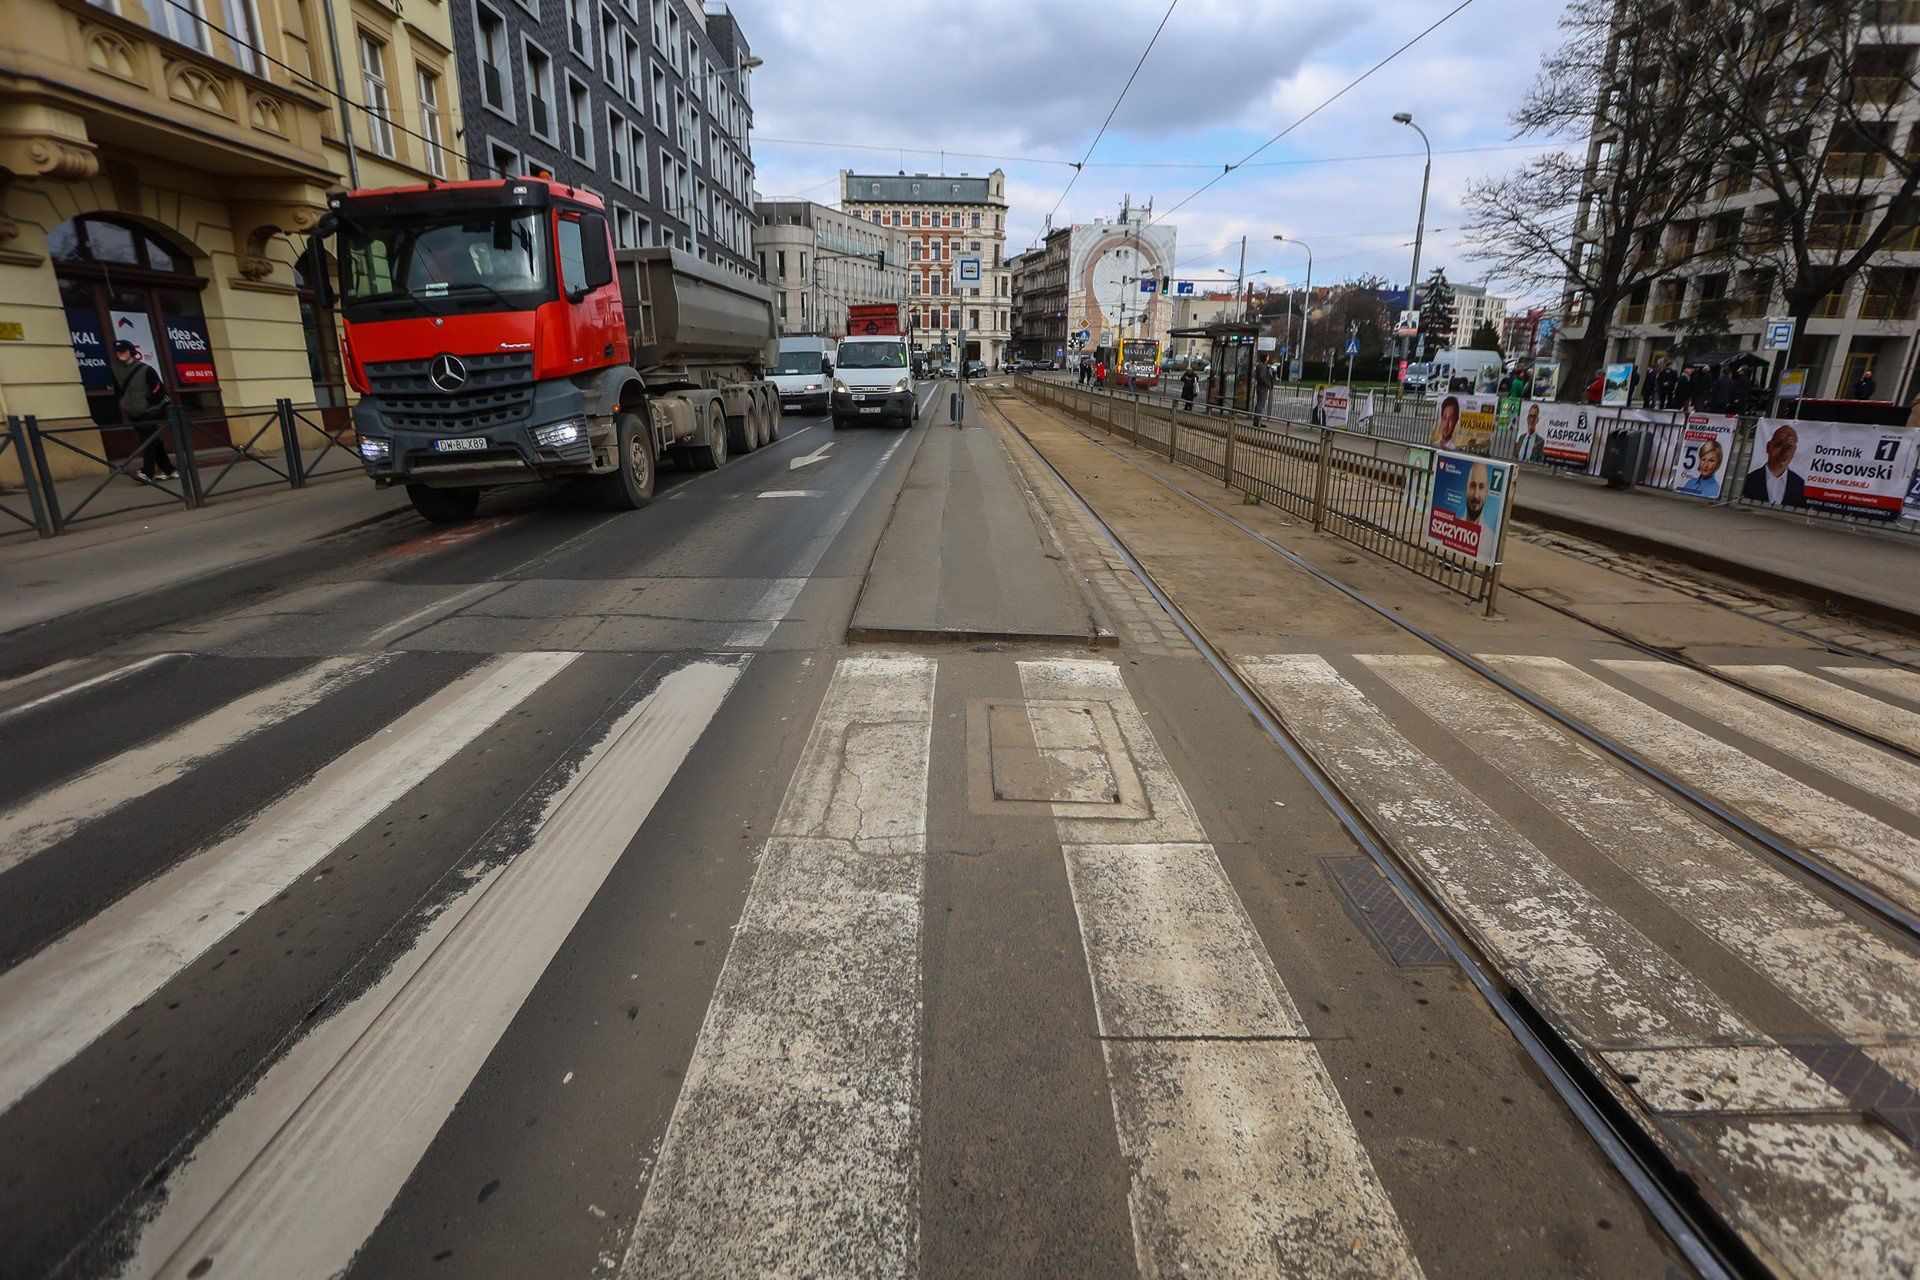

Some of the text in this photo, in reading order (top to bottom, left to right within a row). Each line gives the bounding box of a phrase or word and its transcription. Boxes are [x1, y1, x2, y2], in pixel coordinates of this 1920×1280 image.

[72, 332, 99, 345] KAL
[166, 326, 190, 340] idea
[175, 340, 206, 350] invest
[1579, 416, 1586, 428] 3
[1546, 428, 1592, 444] KASPRZAK
[441, 440, 453, 451] DW
[1815, 444, 1863, 459] Dominik
[1880, 442, 1894, 460] 1
[1683, 446, 1698, 470] 5
[1810, 458, 1893, 480] Kłosowski
[1493, 470, 1502, 489] 7
[1431, 519, 1478, 546] SZCZYTKO
